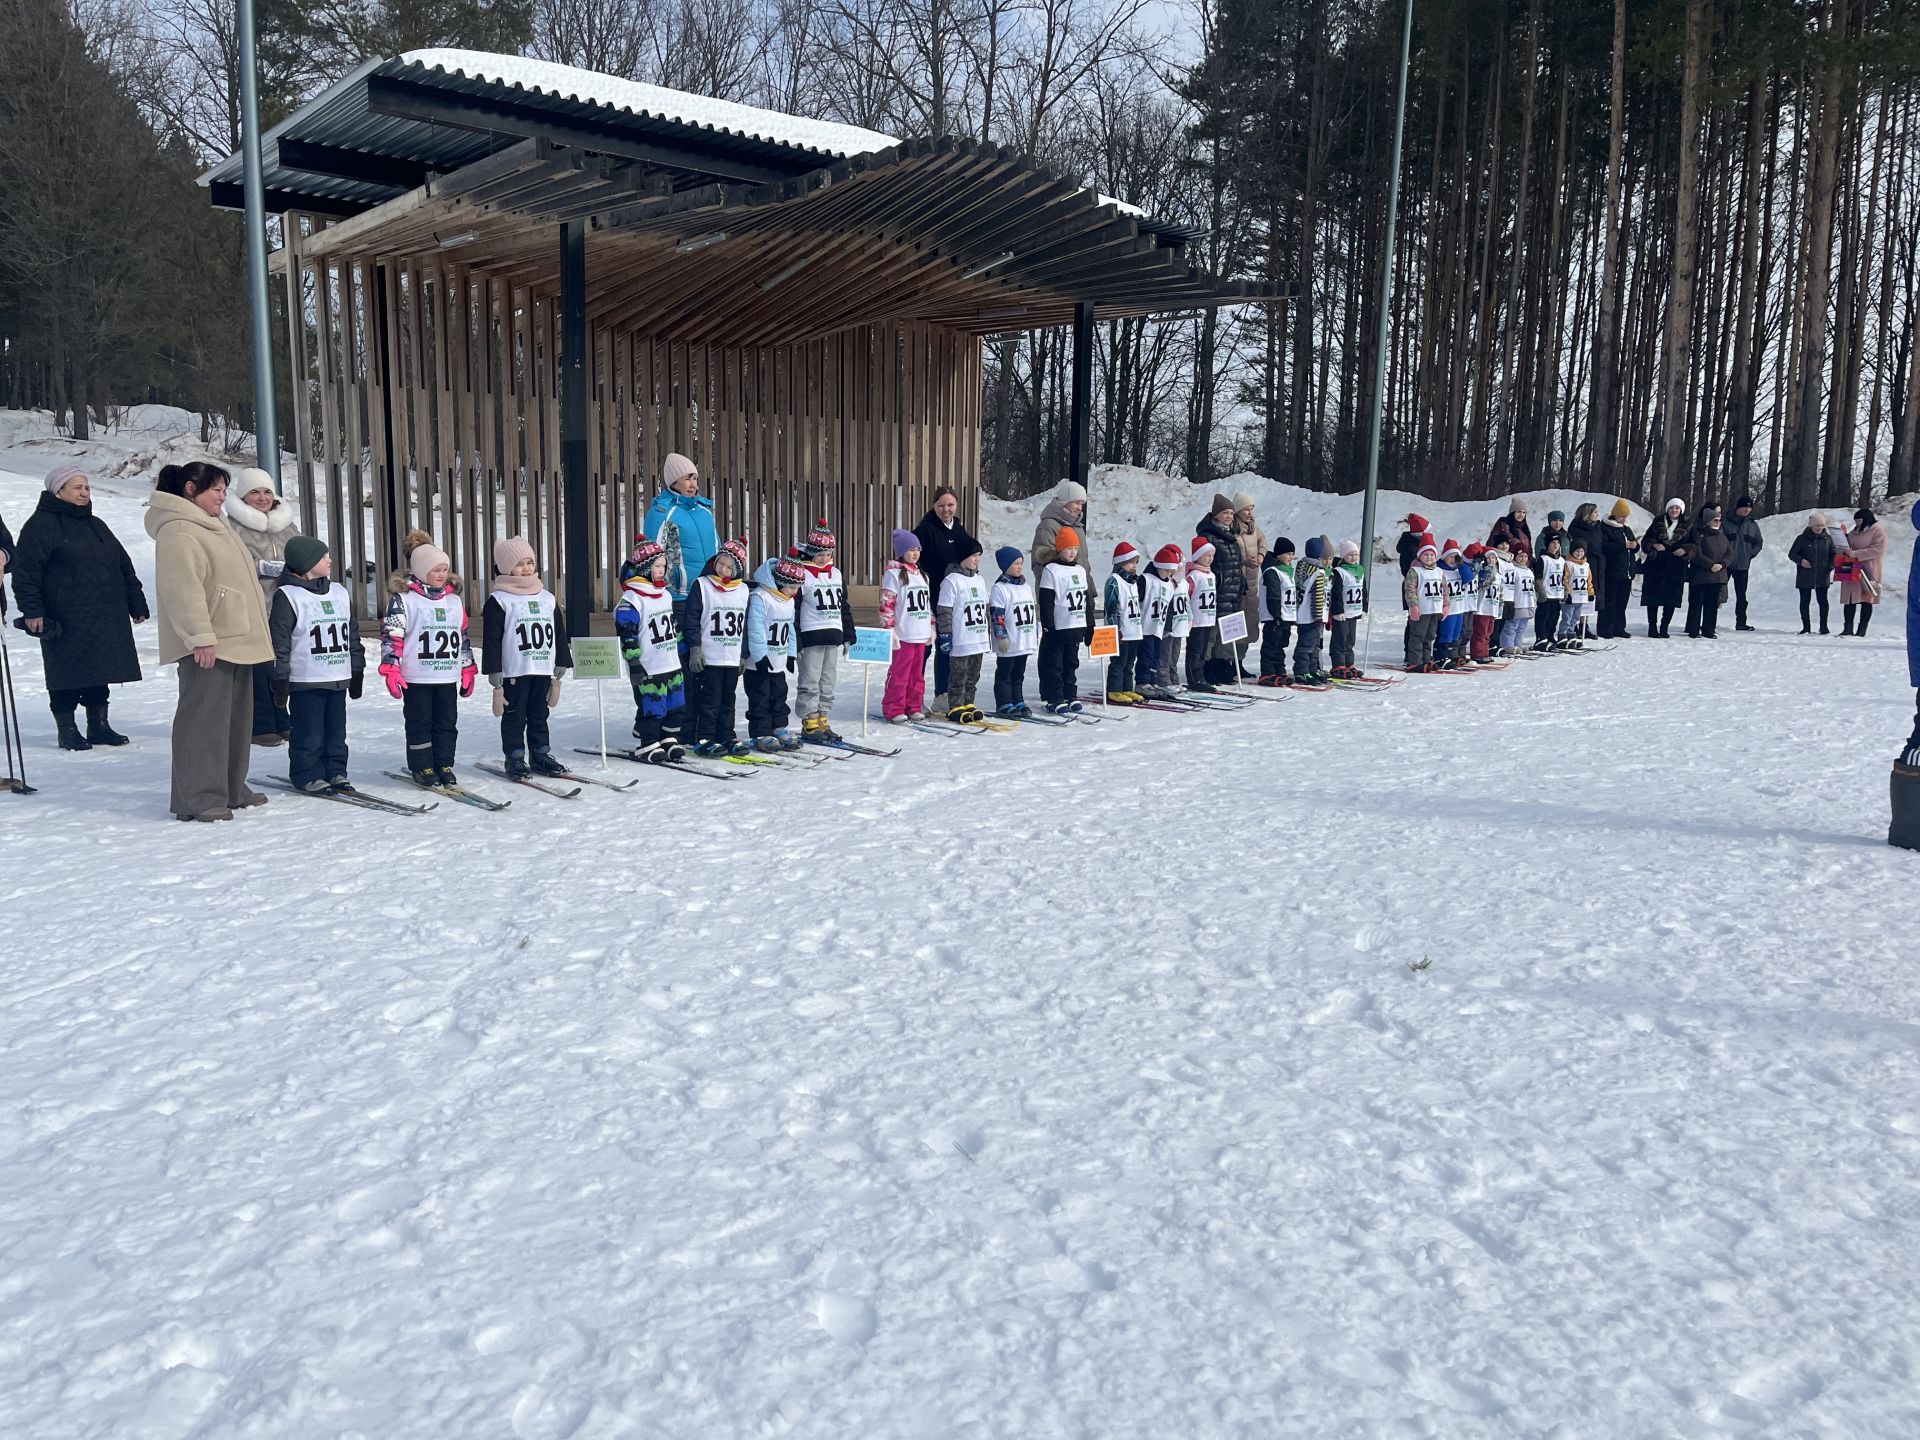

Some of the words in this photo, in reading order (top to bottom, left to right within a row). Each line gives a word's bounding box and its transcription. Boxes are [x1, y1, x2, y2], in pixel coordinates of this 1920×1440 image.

[710, 610, 744, 637] 138
[1013, 604, 1034, 627] 117
[310, 622, 349, 655] 119
[418, 630, 460, 659] 129
[515, 622, 554, 652] 109
